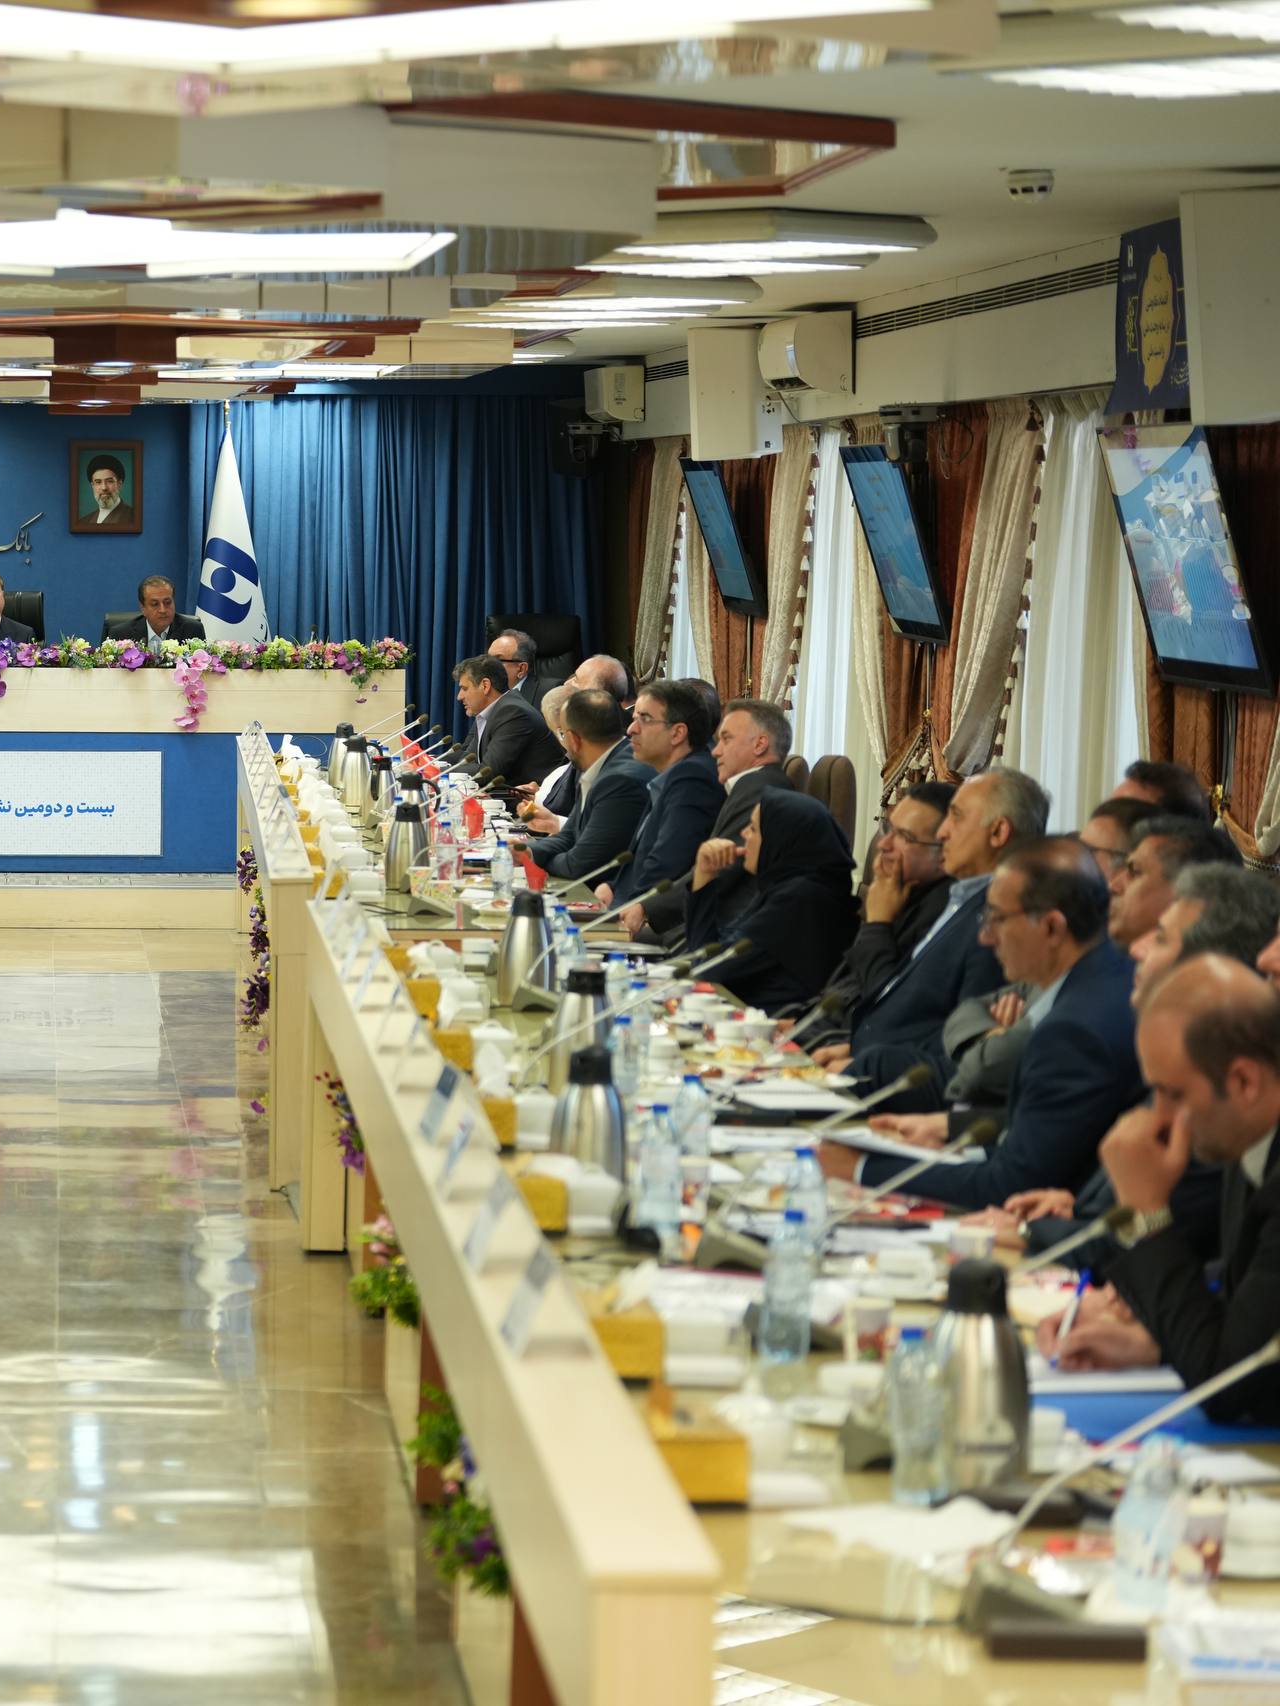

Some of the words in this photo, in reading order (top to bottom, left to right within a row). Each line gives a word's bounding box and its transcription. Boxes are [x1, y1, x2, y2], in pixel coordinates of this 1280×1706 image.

[14, 802, 63, 817] دومین
[63, 804, 74, 817] و
[76, 802, 115, 817] بیست
